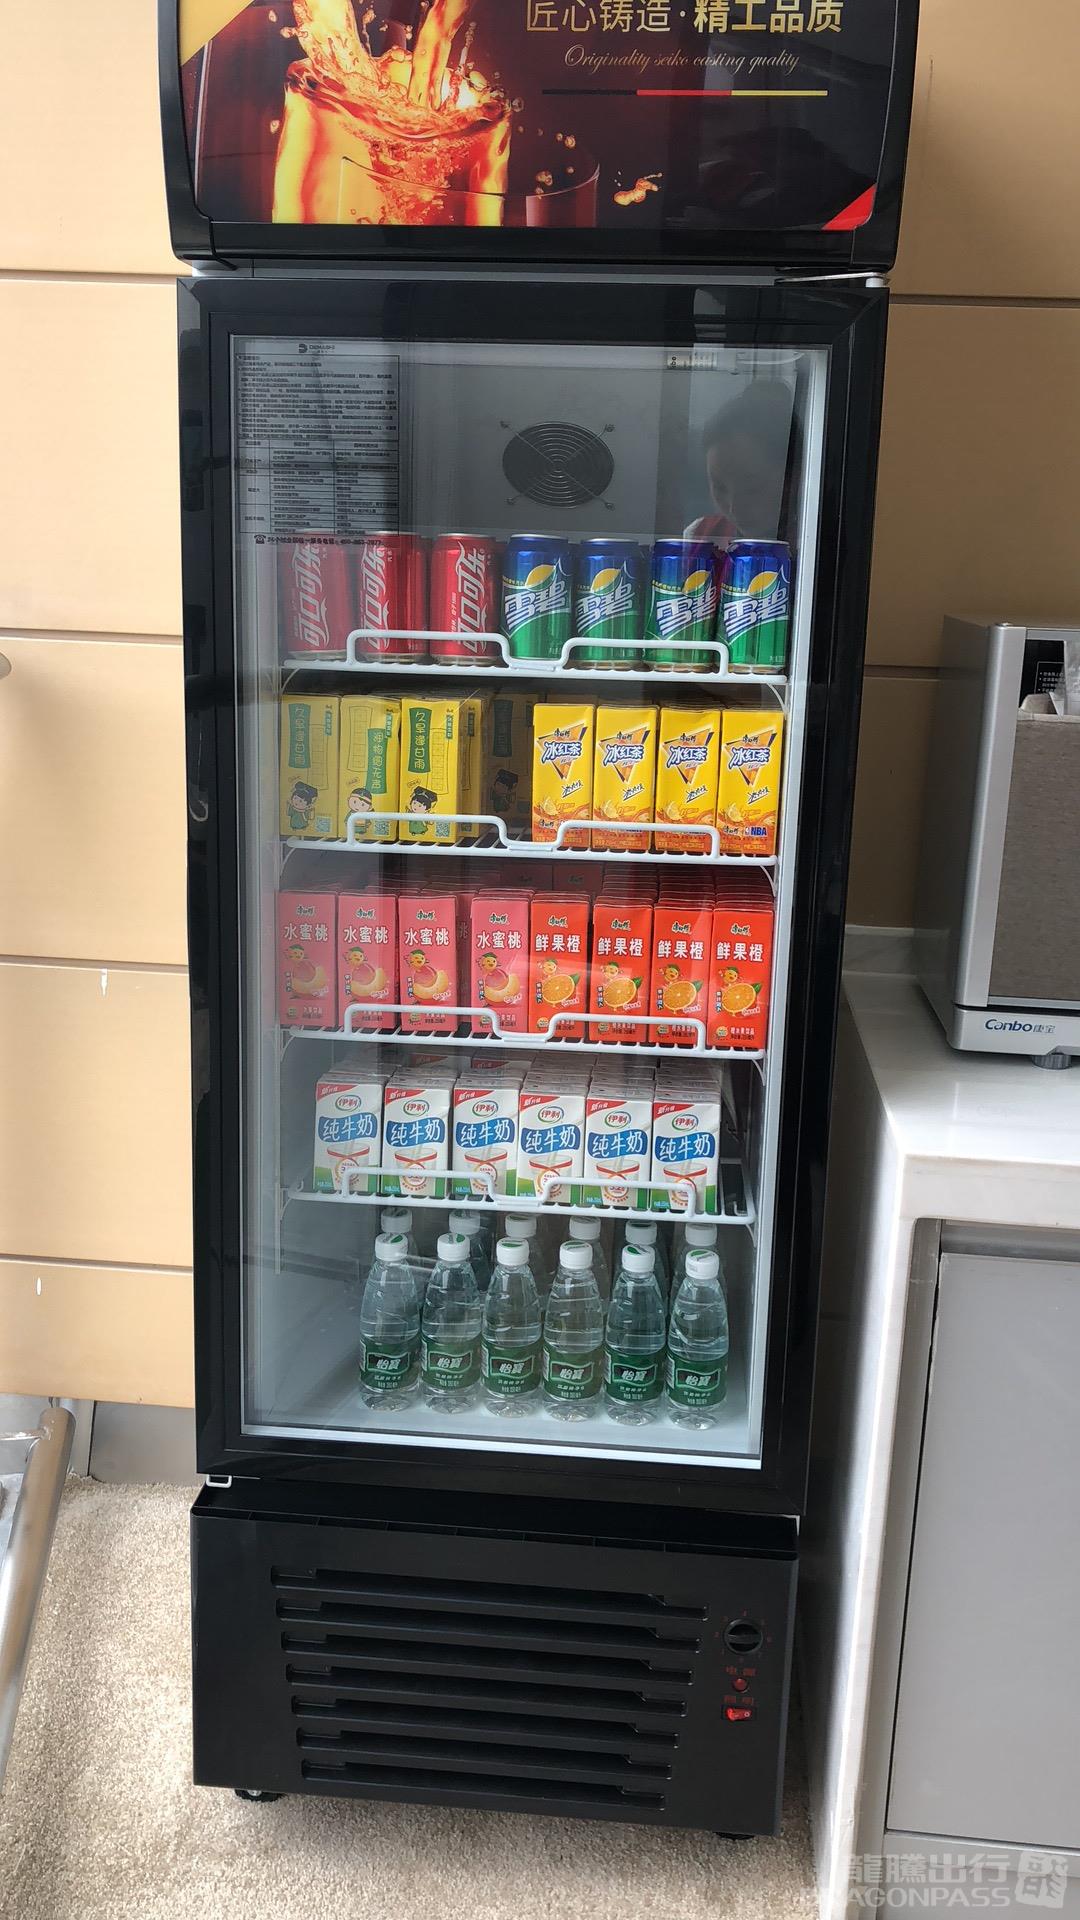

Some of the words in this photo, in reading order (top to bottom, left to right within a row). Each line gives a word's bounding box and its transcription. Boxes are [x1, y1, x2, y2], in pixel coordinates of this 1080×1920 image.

[526, 0, 844, 33] 匠心铸造·精工品质
[565, 44, 651, 74] Originality
[653, 49, 689, 66] seiko
[693, 49, 745, 74] casting
[748, 48, 801, 75] quality
[504, 580, 566, 631] 雪碧
[577, 583, 634, 634] 雪碧
[656, 585, 719, 637] 雪碧
[723, 587, 787, 638] 雪碧
[542, 741, 583, 763] 冰红茶
[603, 744, 644, 766] 冰红茶
[666, 746, 707, 768] 冰红茶
[729, 747, 770, 769] 冰红茶
[751, 826, 767, 836] NBA
[284, 922, 329, 942] 水蜜桃
[343, 925, 388, 944] 水蜜桃
[404, 927, 450, 947] 水蜜桃
[476, 930, 522, 949] 水蜜桃
[535, 934, 581, 953] 鲜果橙
[597, 937, 643, 957] 鲜果橙
[657, 940, 704, 960] 鲜果橙
[716, 941, 763, 962] 鲜果橙
[985, 1018, 1033, 1032] Canbo
[338, 1097, 358, 1108] 伊利
[406, 1103, 425, 1113] 伊利
[475, 1103, 495, 1114] 伊利
[540, 1110, 560, 1119] 伊利
[608, 1114, 627, 1124] 伊利
[674, 1117, 694, 1127] 伊利
[322, 1114, 373, 1141] 纯牛奶
[391, 1119, 441, 1146] 纯牛奶
[460, 1120, 511, 1147] 纯牛奶
[525, 1125, 576, 1152] 纯牛奶
[592, 1130, 643, 1157] 纯牛奶
[659, 1134, 710, 1162] 纯牛奶
